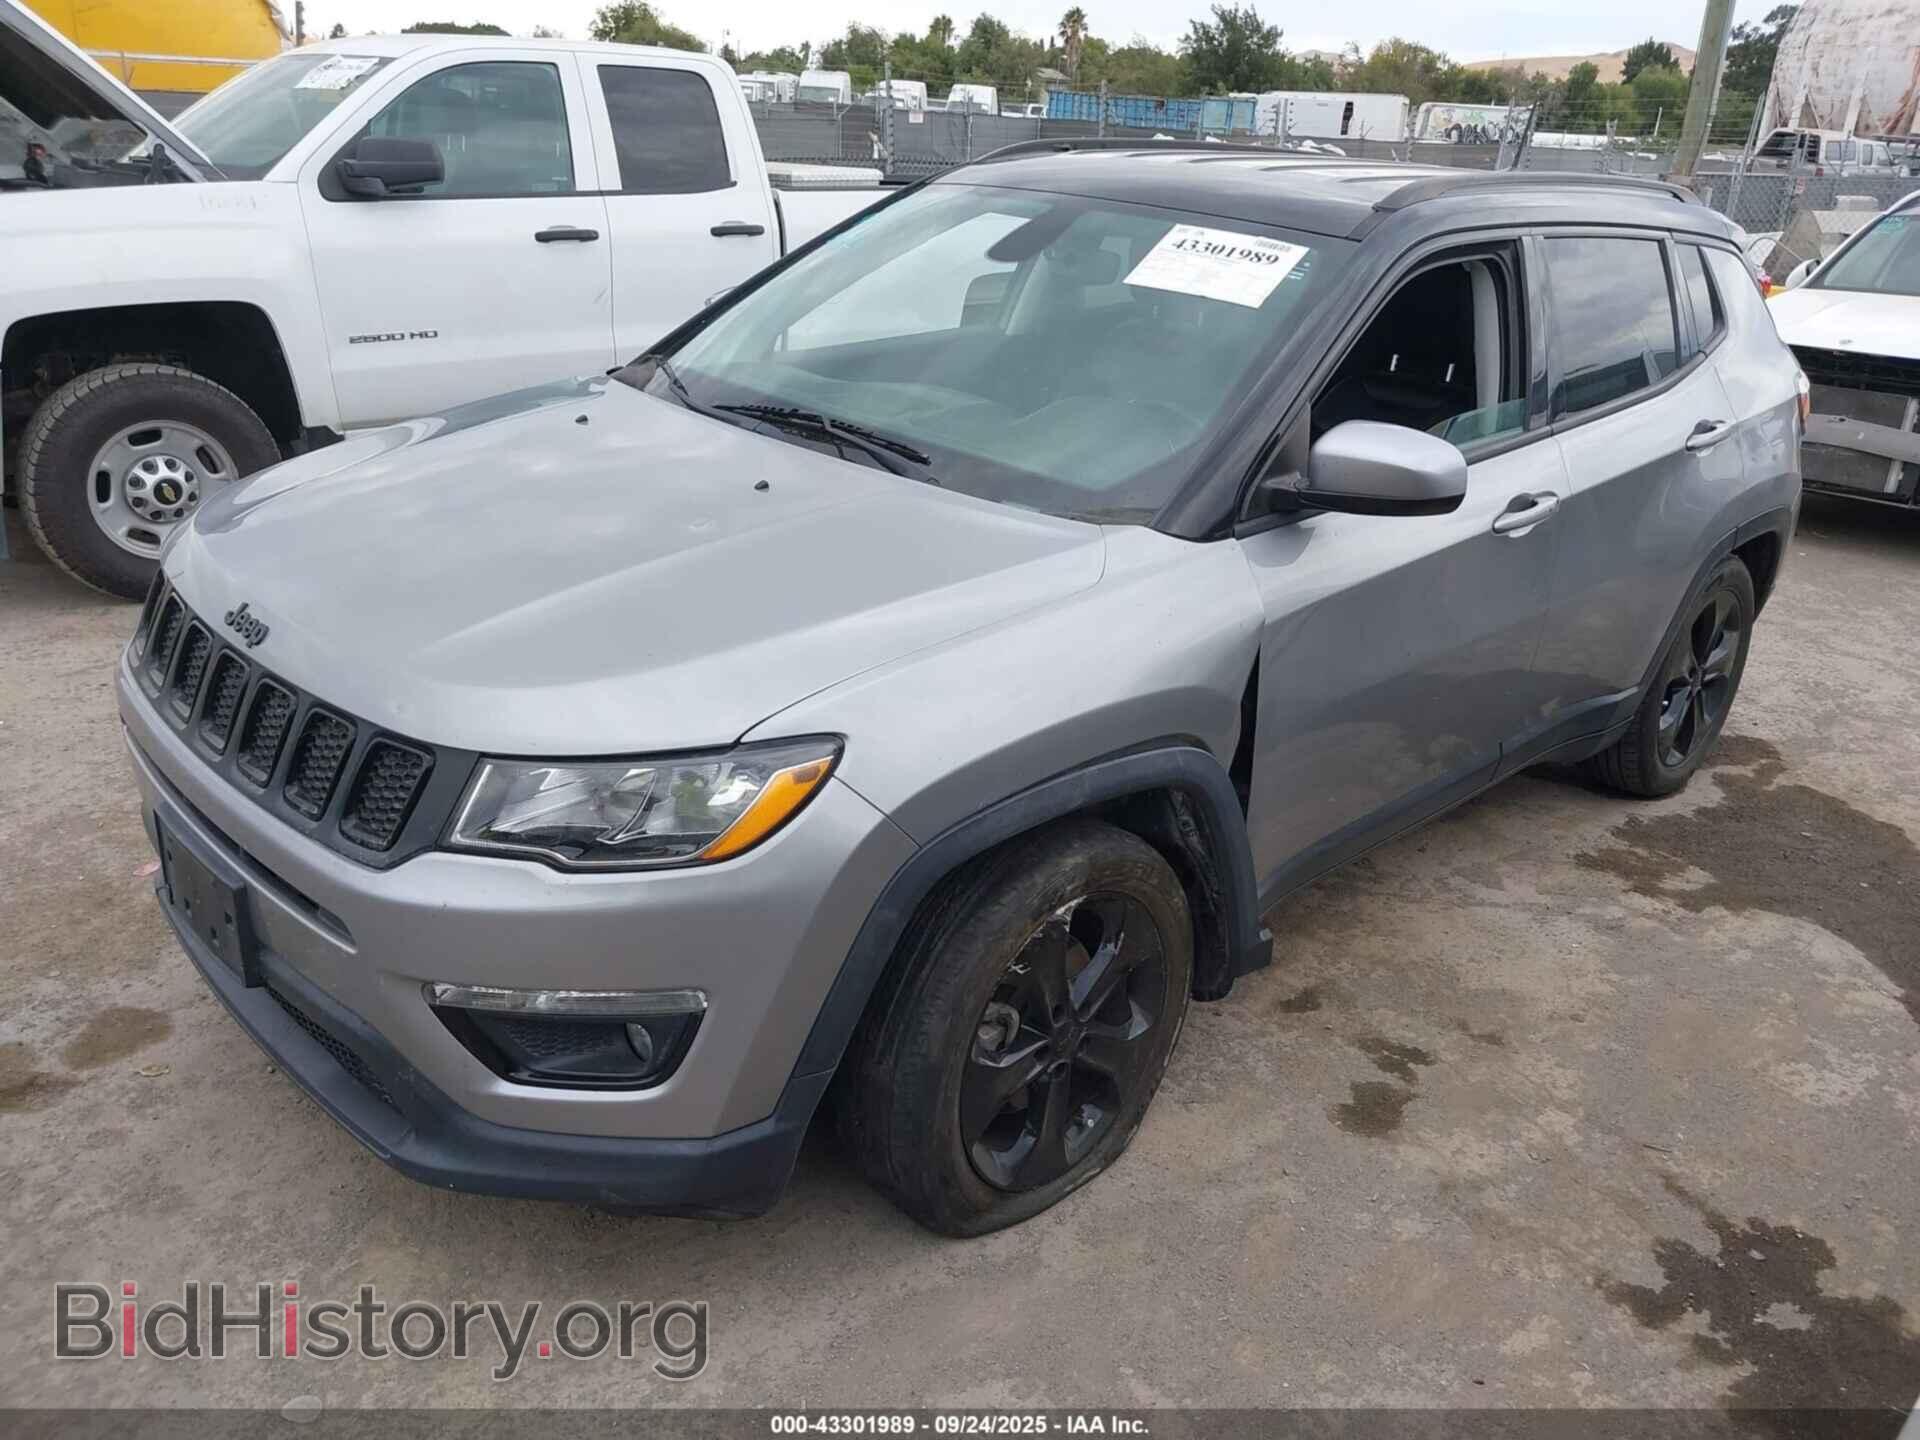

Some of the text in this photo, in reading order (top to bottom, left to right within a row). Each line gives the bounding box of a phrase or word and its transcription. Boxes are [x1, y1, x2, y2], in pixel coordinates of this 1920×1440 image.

[1172, 238, 1280, 265] 43301989
[349, 330, 438, 344] 2500 HD
[224, 602, 270, 649] Jeep
